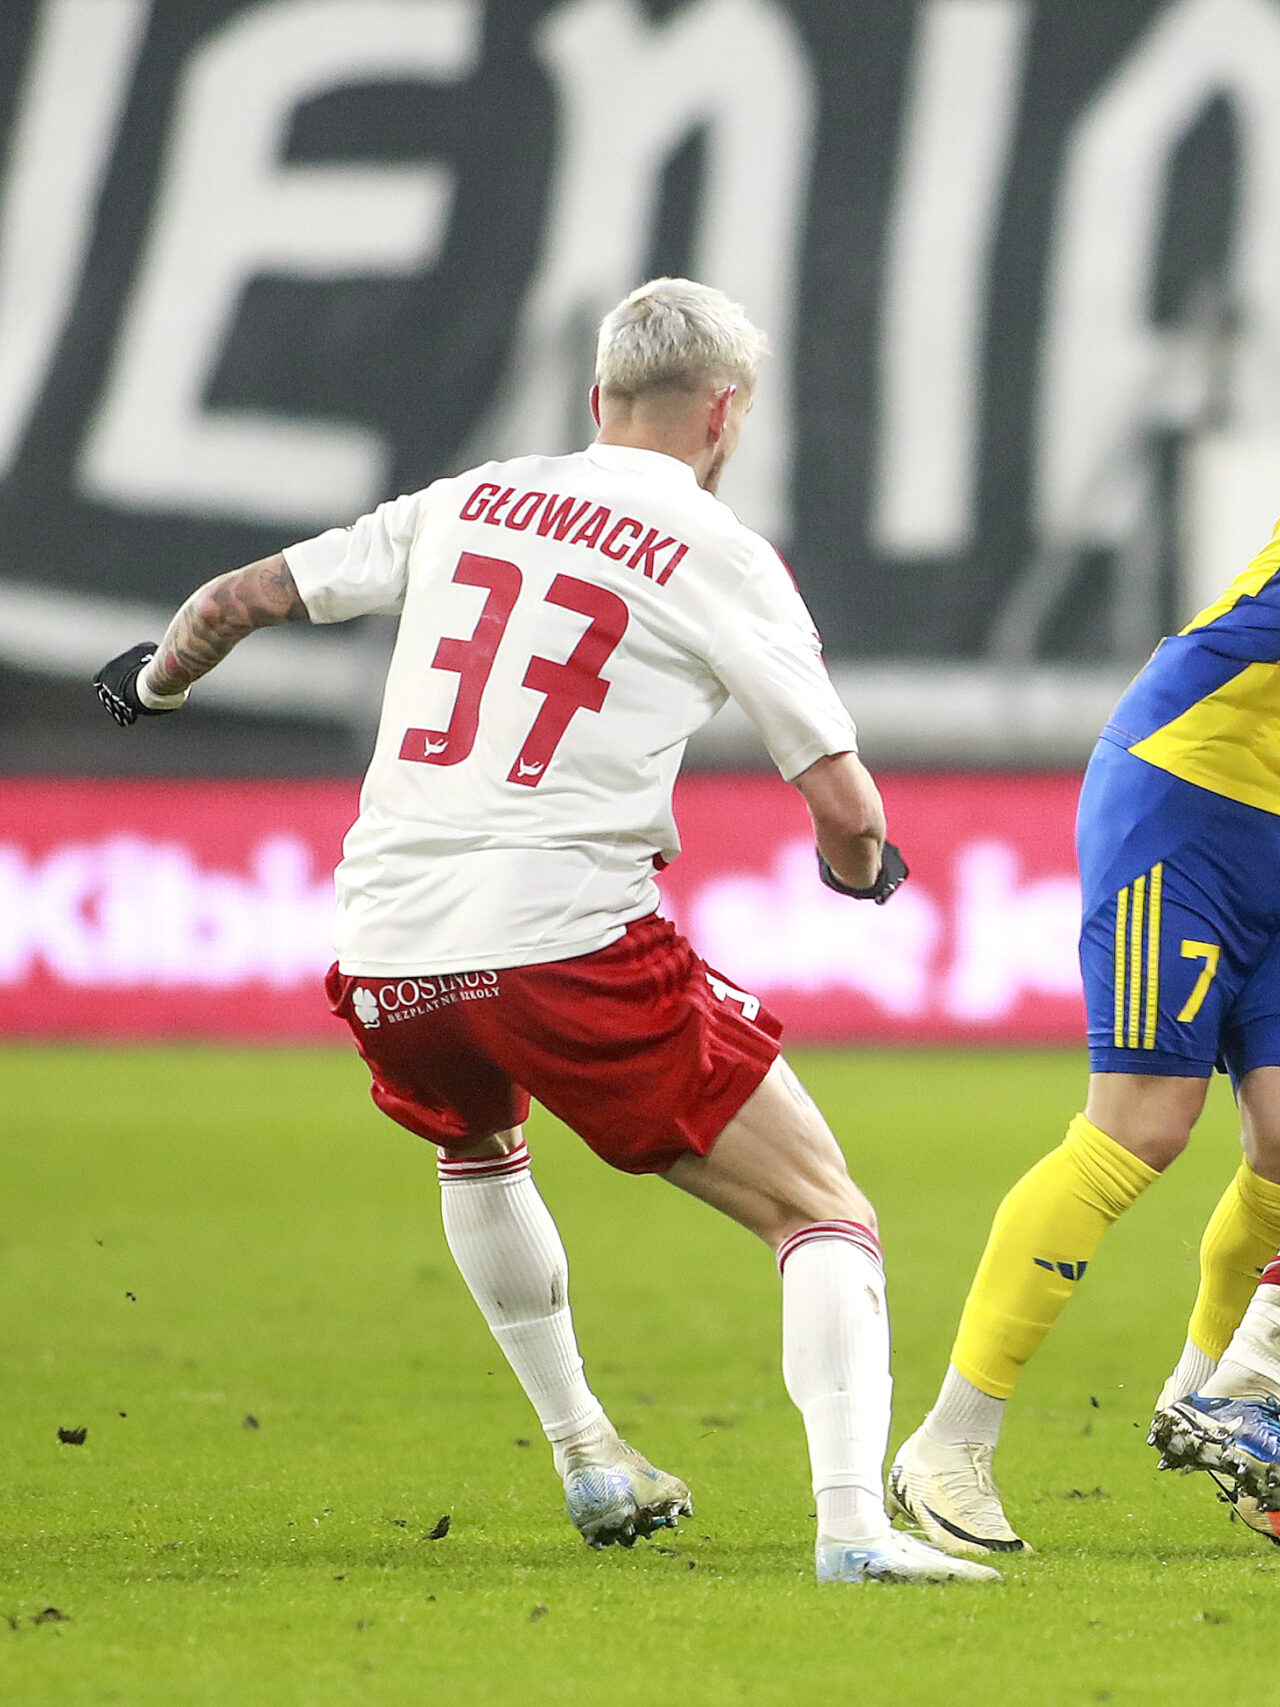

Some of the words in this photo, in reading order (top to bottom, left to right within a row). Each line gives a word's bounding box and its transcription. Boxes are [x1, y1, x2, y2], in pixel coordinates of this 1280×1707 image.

[459, 482, 690, 587] GŁOWACKI
[398, 551, 630, 788] 37
[1176, 938, 1220, 1023] 7
